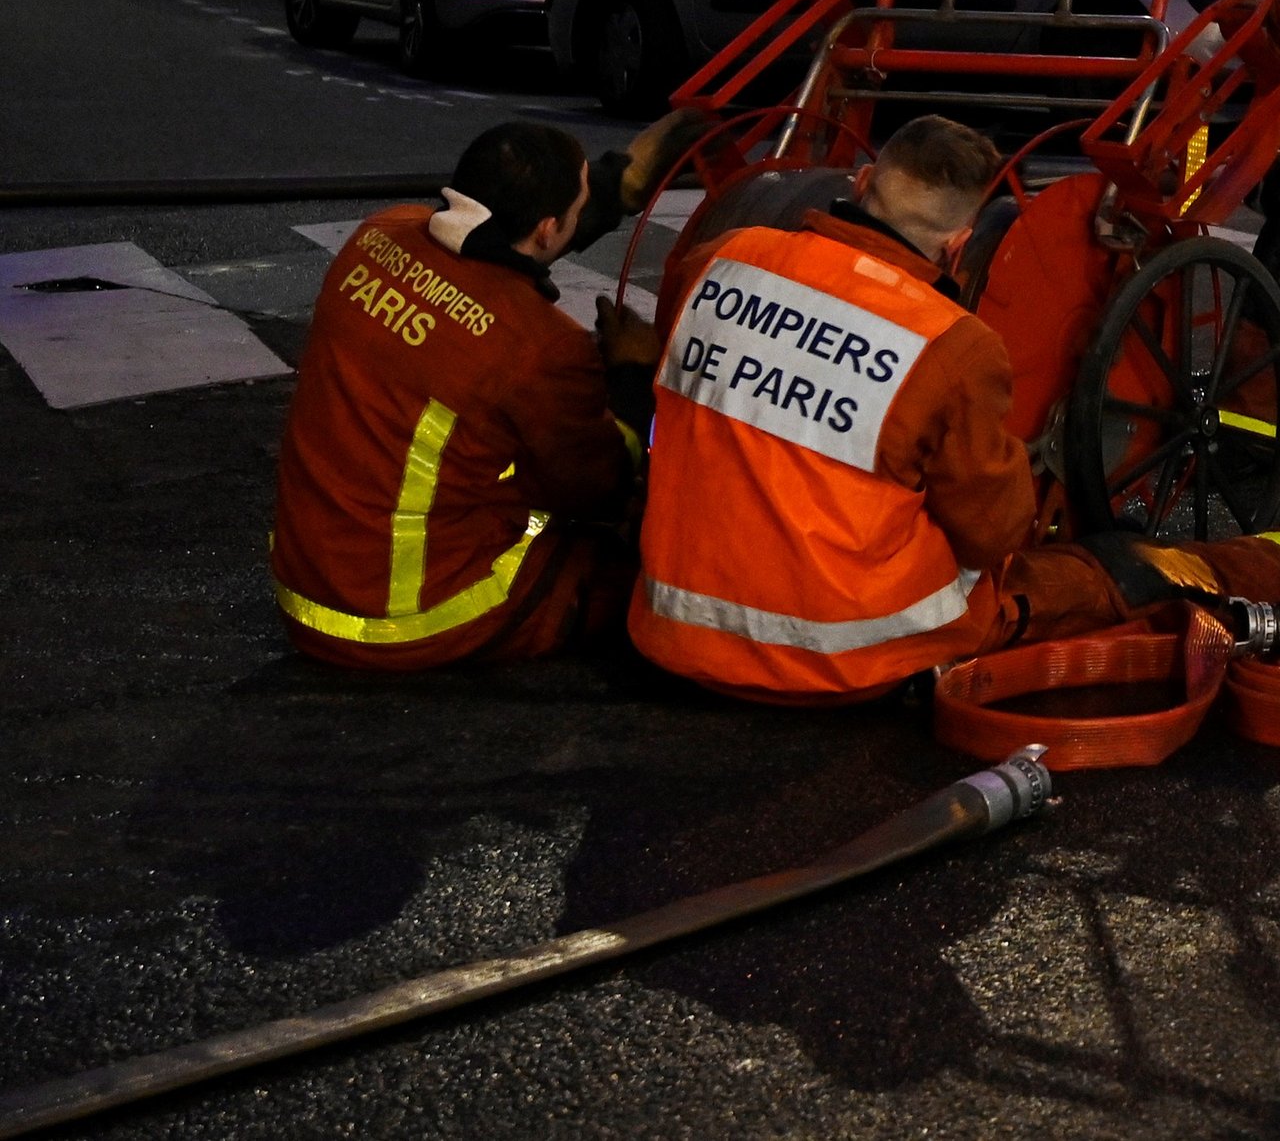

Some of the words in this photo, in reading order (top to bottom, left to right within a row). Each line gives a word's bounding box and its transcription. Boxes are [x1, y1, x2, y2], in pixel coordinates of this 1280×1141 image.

[339, 263, 436, 347] PARIS
[402, 260, 495, 336] POMPIERS
[692, 280, 899, 382] POMPIERS
[681, 337, 727, 381] DE
[729, 355, 858, 433] PARIS
